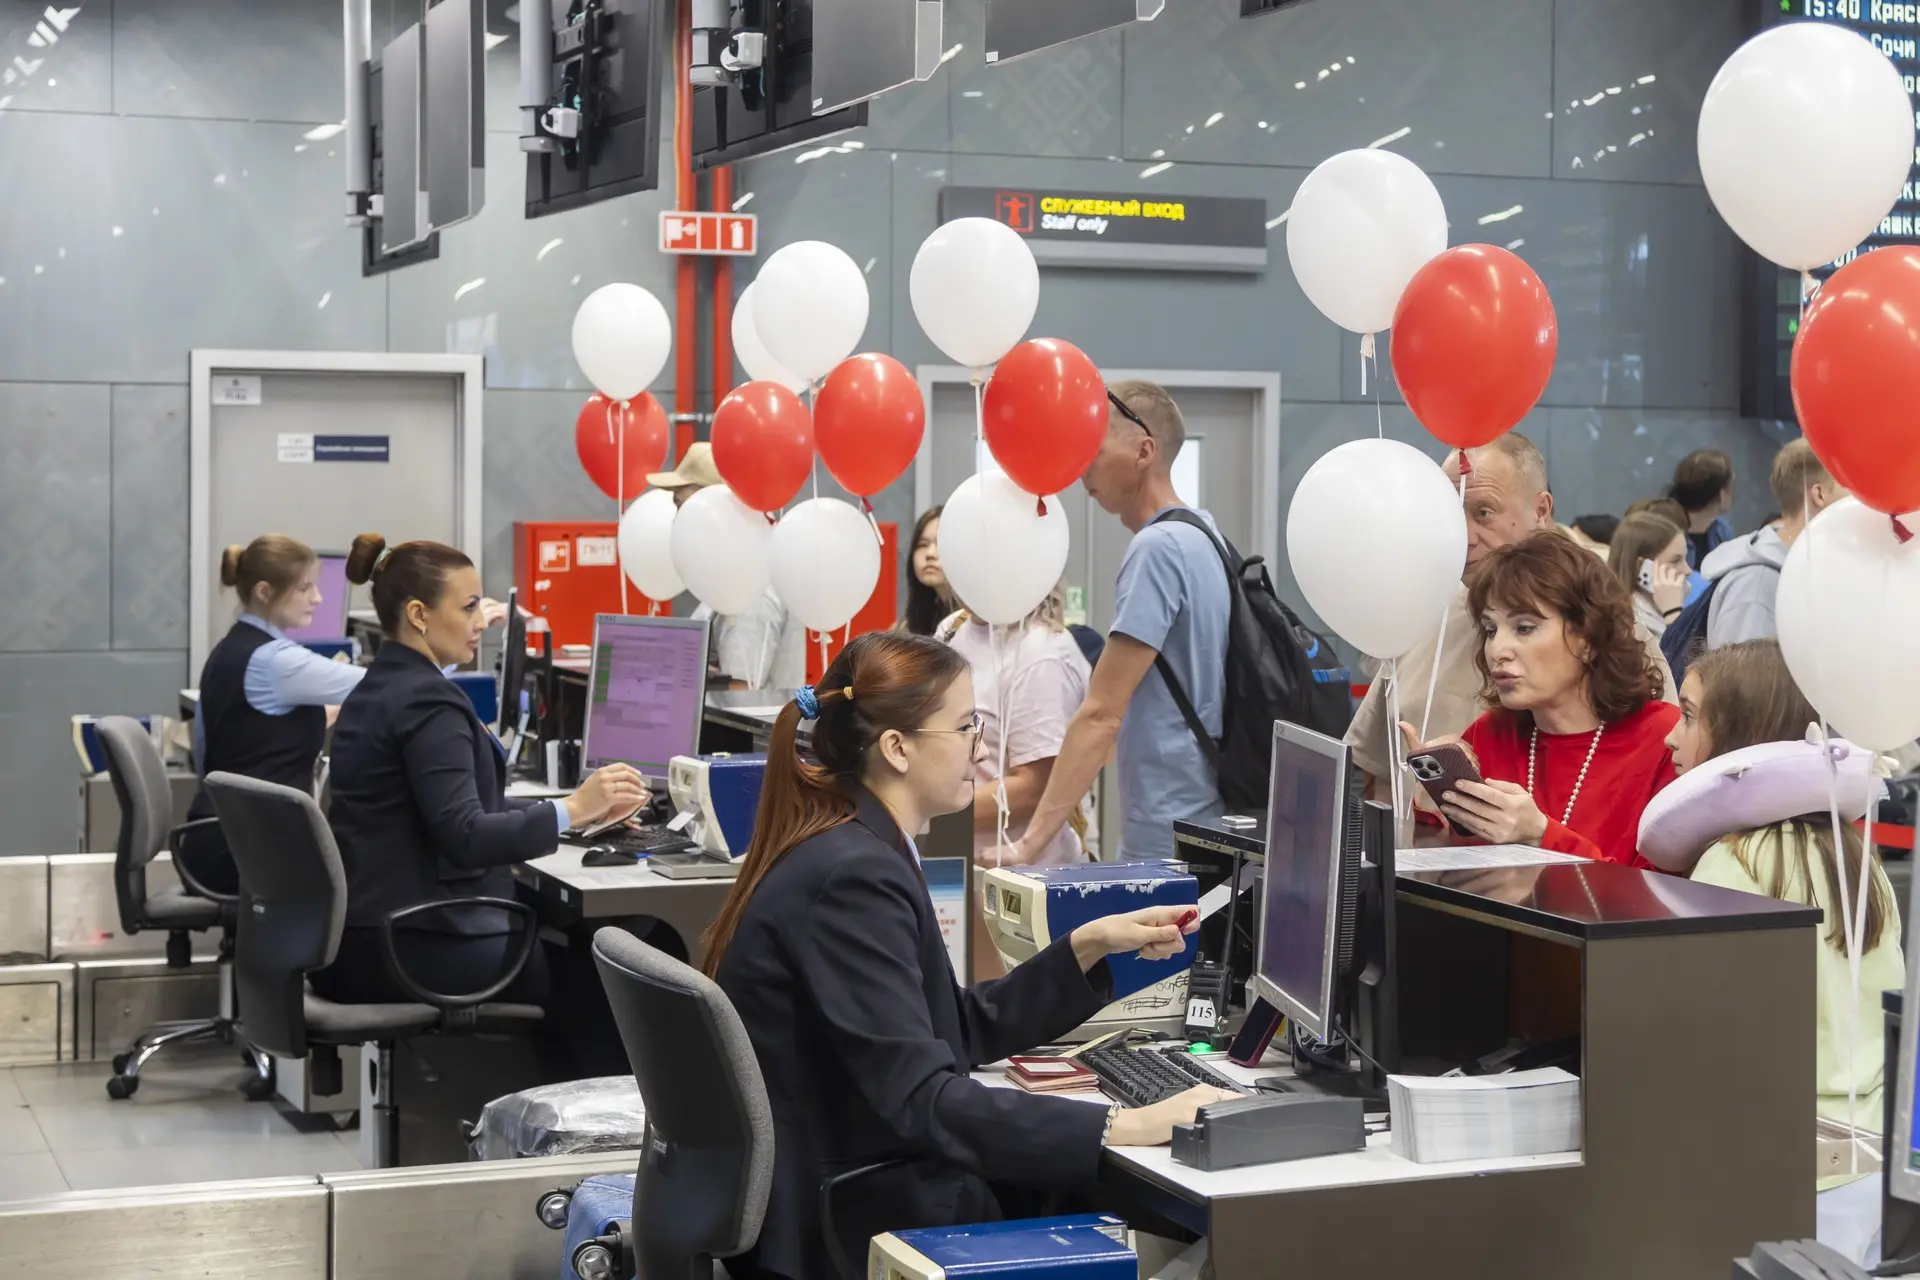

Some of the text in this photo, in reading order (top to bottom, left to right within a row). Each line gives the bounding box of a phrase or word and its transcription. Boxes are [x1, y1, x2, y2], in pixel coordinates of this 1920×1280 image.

[1040, 197, 1185, 221] СЛУЖЕБНЫЙ ВХОД
[1041, 214, 1108, 234] Staff only
[1191, 1006, 1213, 1018] 115
